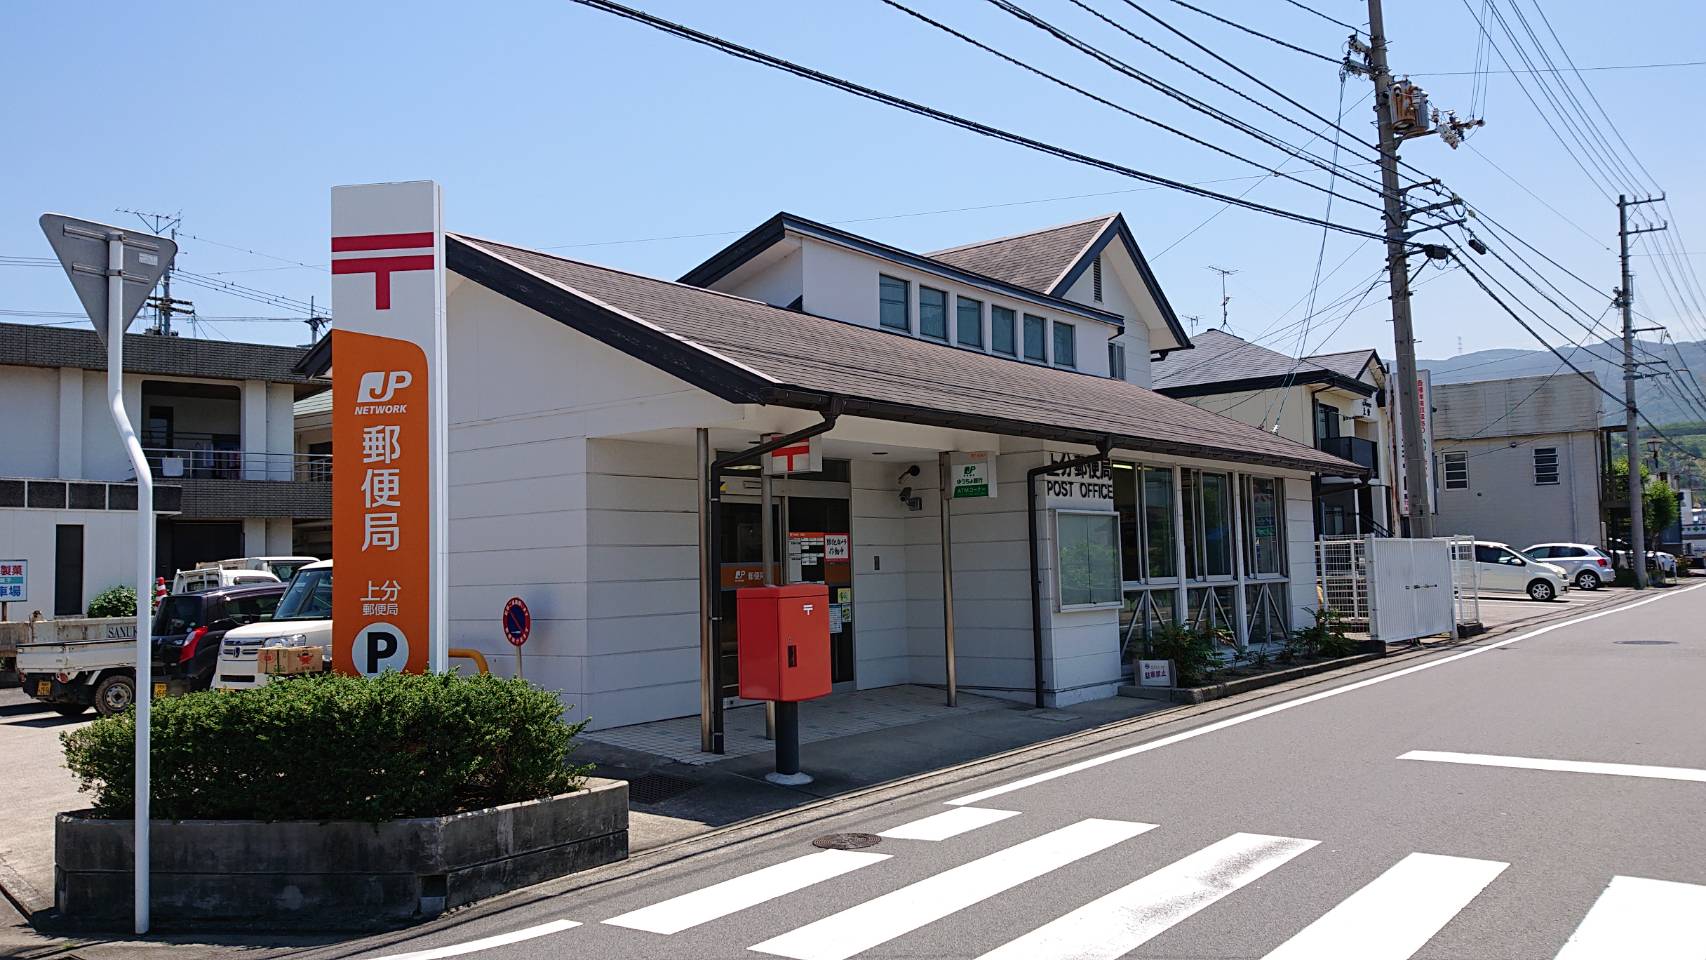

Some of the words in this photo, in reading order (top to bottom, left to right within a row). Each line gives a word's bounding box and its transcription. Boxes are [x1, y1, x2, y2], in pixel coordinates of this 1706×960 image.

[357, 371, 413, 402] JP
[354, 404, 408, 415] NETWORK
[360, 425, 401, 552] 郵便局
[1047, 481, 1074, 497] POST
[1080, 483, 1114, 499] OFFICE
[360, 580, 401, 601] 上分
[362, 603, 399, 616] 郵便局
[367, 631, 398, 674] P
